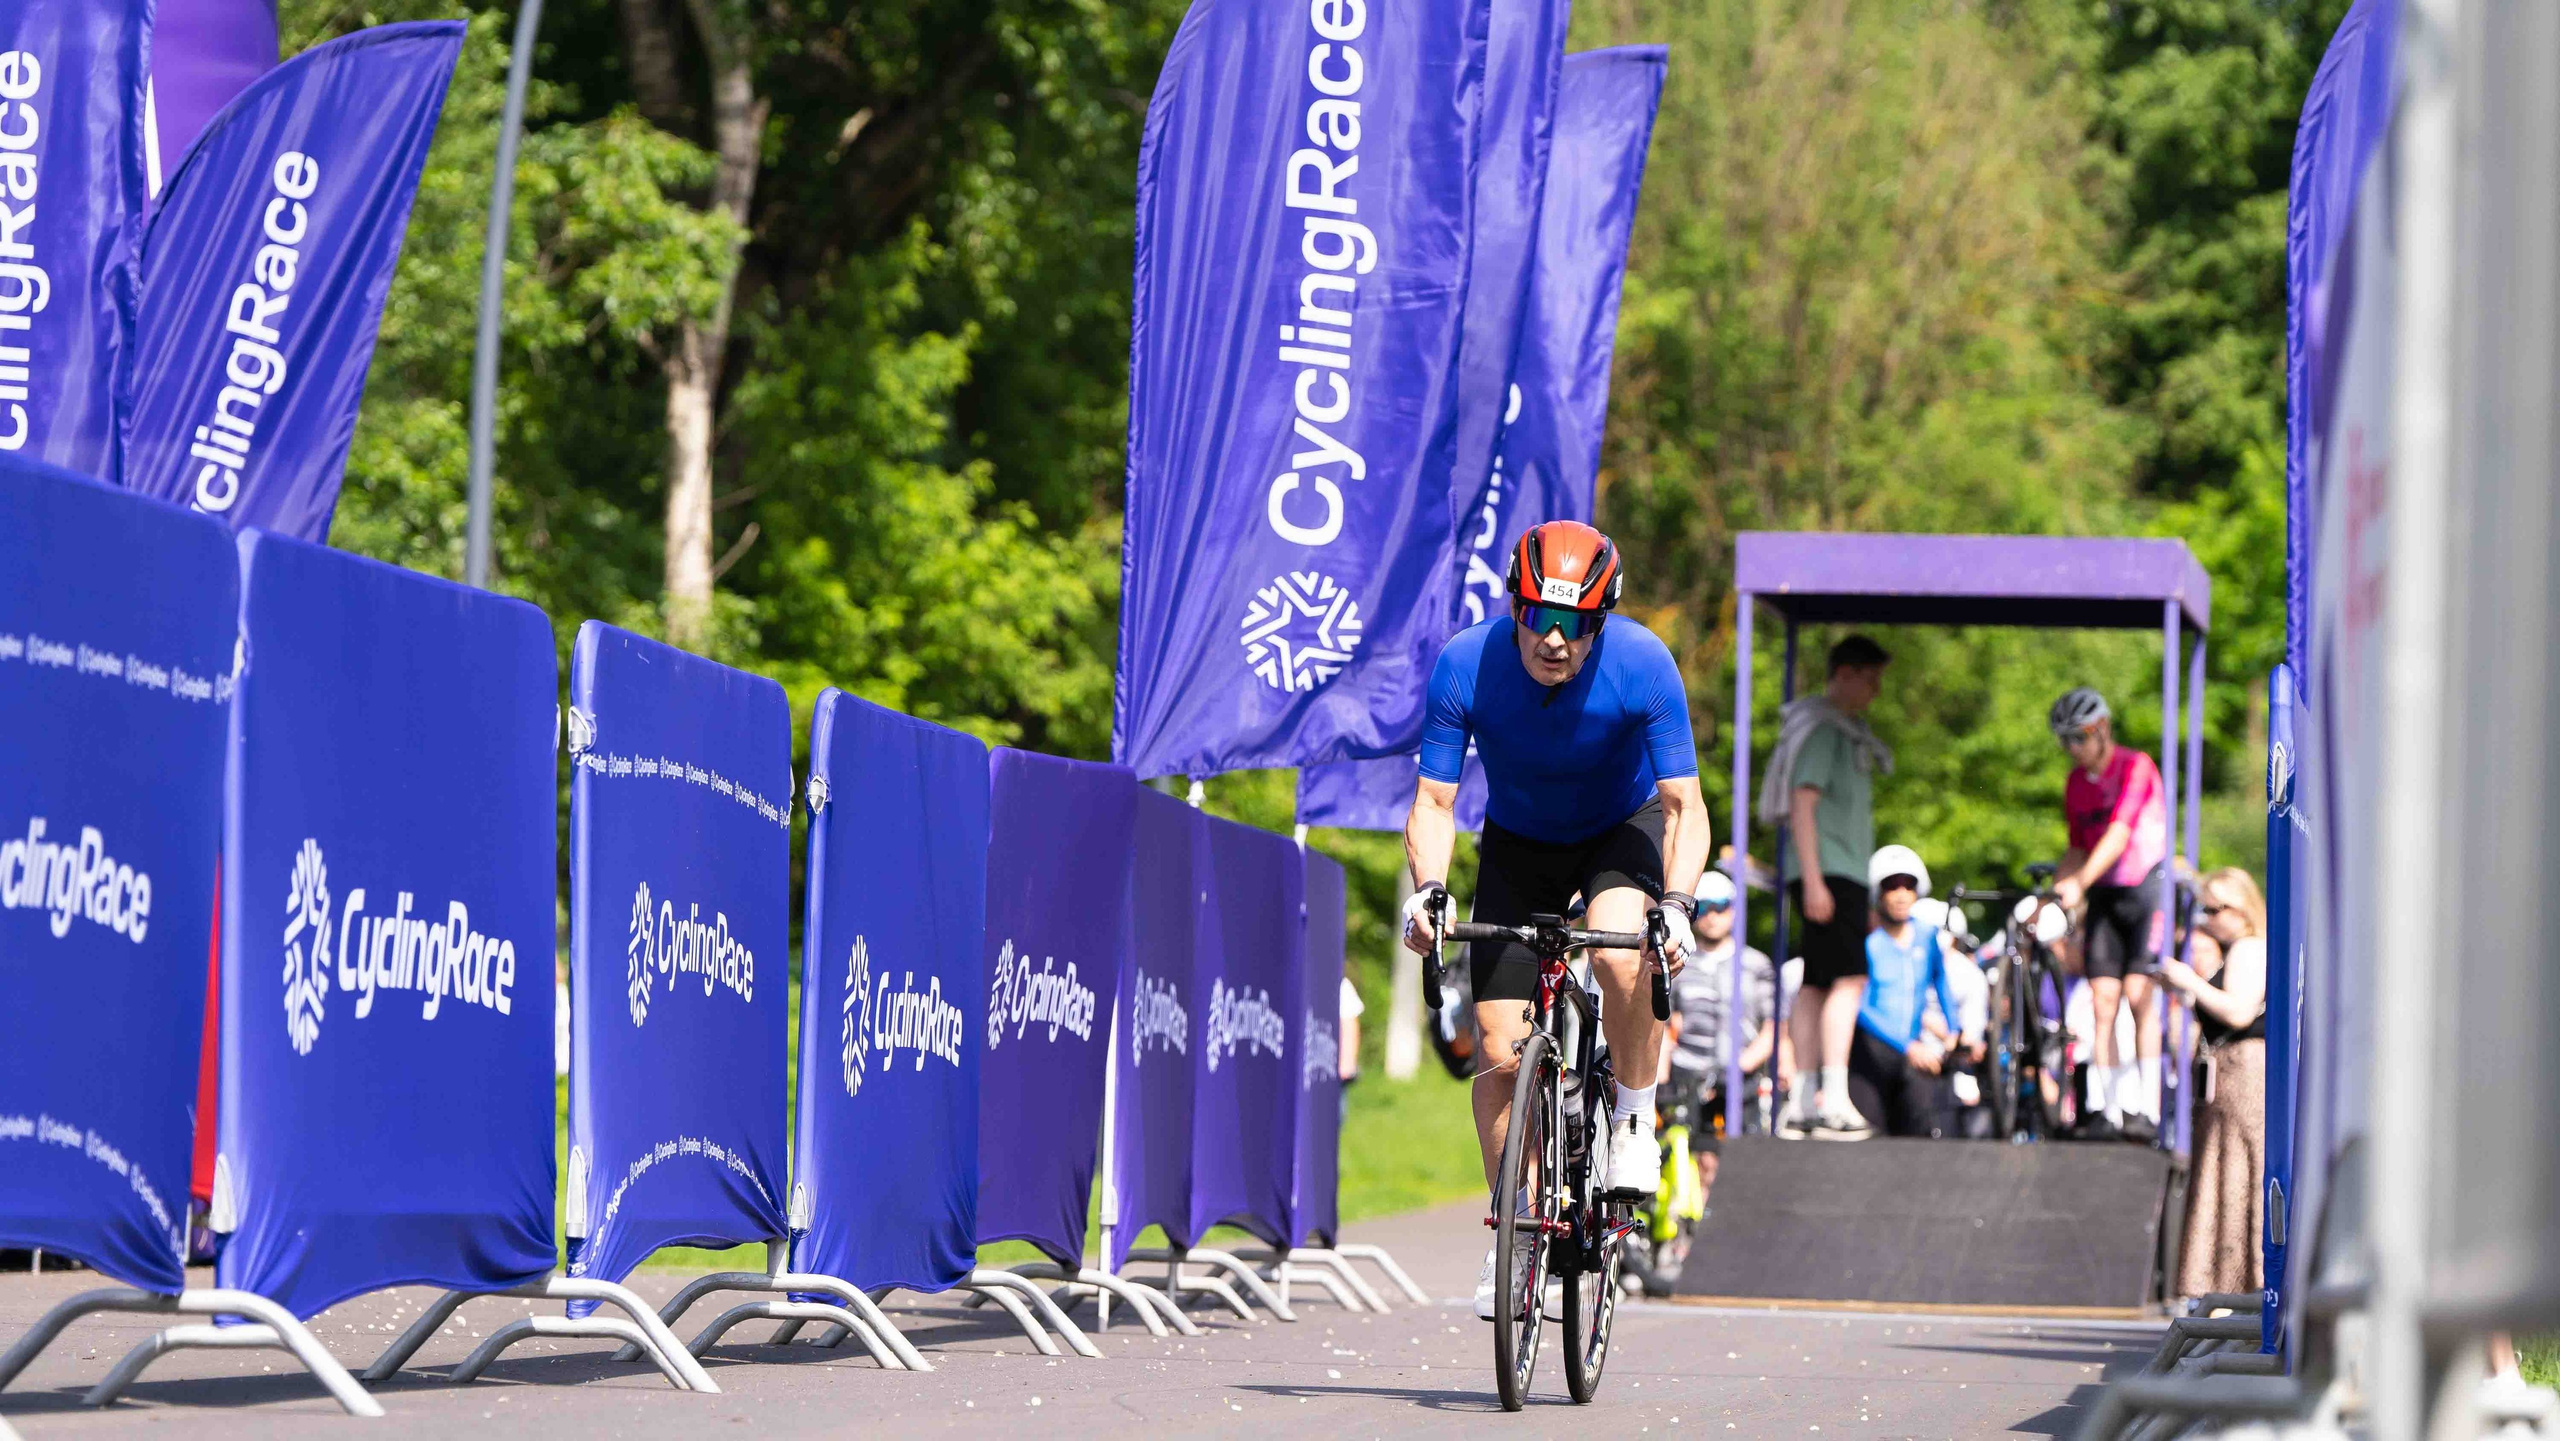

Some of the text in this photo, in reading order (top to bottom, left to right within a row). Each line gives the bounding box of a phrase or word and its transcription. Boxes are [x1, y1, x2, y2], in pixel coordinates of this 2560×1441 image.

[1267, 0, 1378, 546] CyclingRace
[190, 151, 319, 514] clingRace
[1548, 584, 1573, 599] 454
[0, 817, 151, 944] clingRace
[338, 888, 515, 1021] CyclingRace
[658, 899, 753, 1003] CyclingRace
[1011, 955, 1095, 1043] CyclingRace
[875, 971, 962, 1071] CyclingRace
